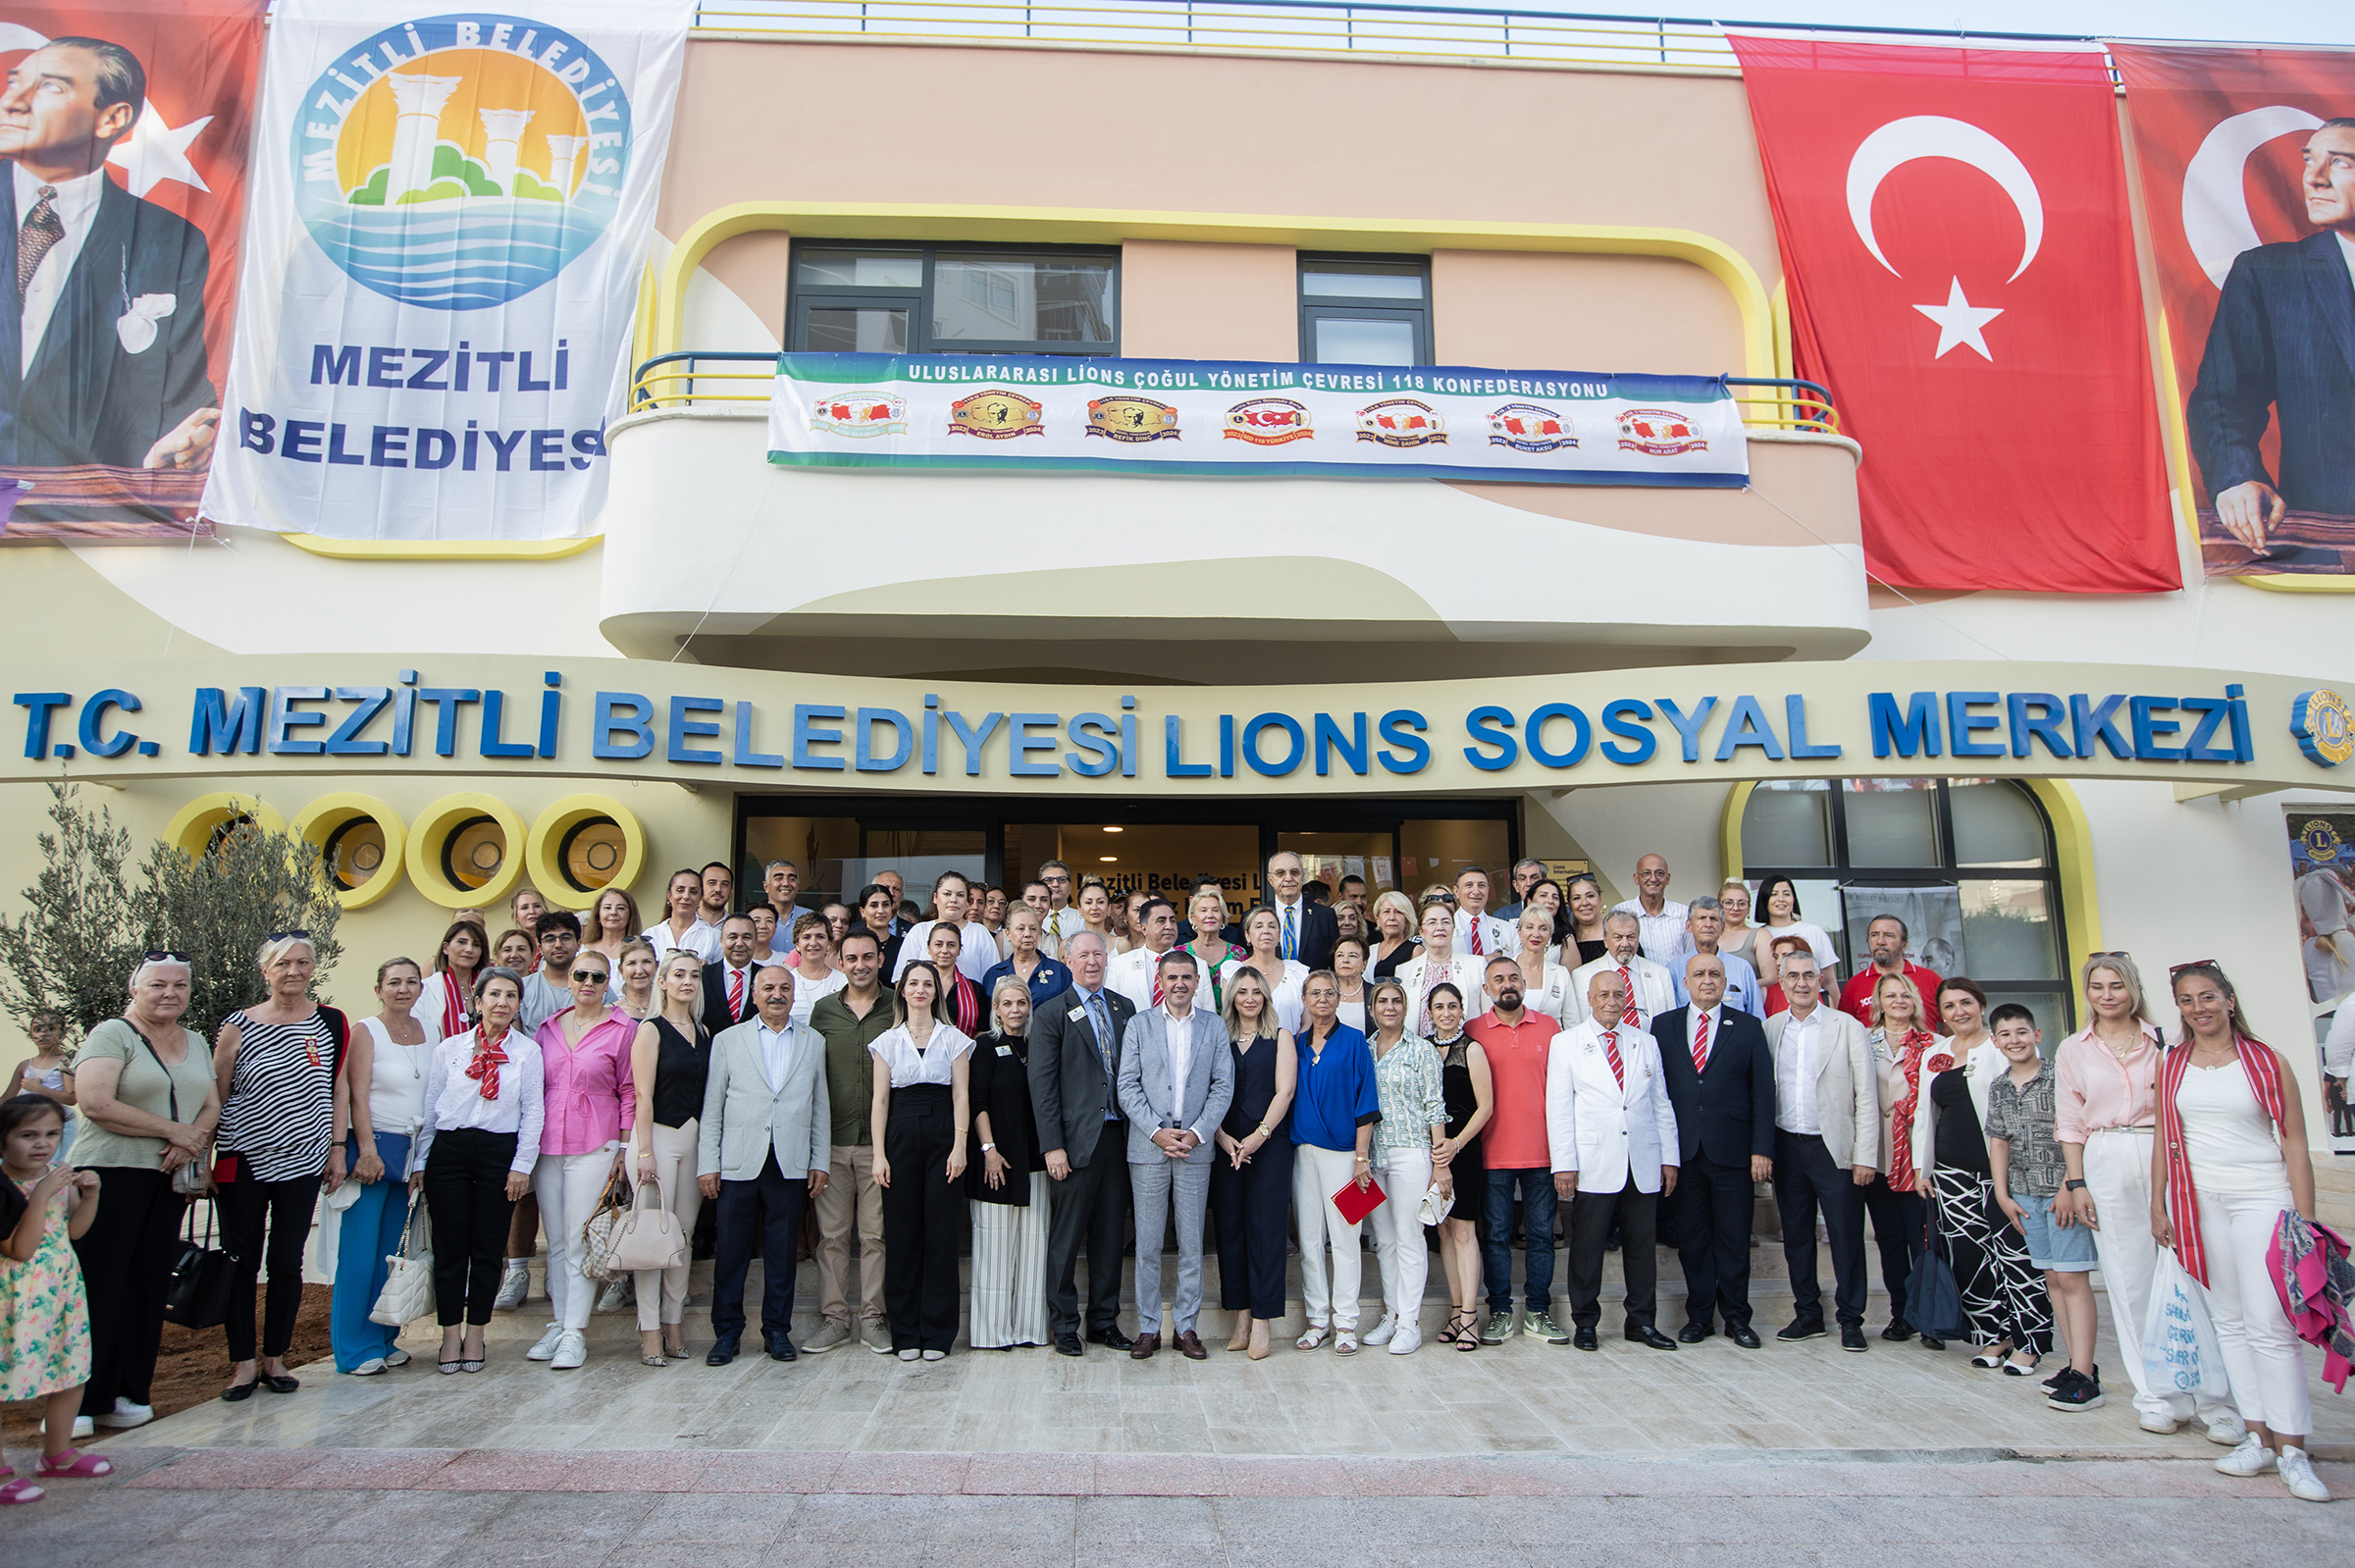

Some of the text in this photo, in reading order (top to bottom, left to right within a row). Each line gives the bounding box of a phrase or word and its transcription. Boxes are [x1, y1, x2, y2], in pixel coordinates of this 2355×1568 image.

[302, 22, 623, 199] MEZİTLİ BELEDİYESİ
[310, 339, 569, 392] MEZİTLİ
[909, 364, 1057, 383] ULUSLARARASI
[1134, 370, 1199, 390] ÇOĞUL
[1207, 369, 1293, 388] YÖNETİM
[1302, 372, 1384, 390] ÇEVRESİ
[1392, 374, 1425, 390] 118
[1433, 377, 1608, 397] KONFEDERASYONU
[1266, 434, 1294, 444] TÜRKİYE
[2311, 692, 2342, 707] LIONS
[14, 669, 2254, 777] T.C. MEZİTLİ BELEDİYESİ LIONS SOSYAL MERKEZİ
[2324, 712, 2341, 738] L
[2306, 820, 2331, 830] LIONS
[2315, 832, 2328, 847] L
[1077, 872, 1142, 890] zitli
[1148, 872, 1246, 890] Beleesi
